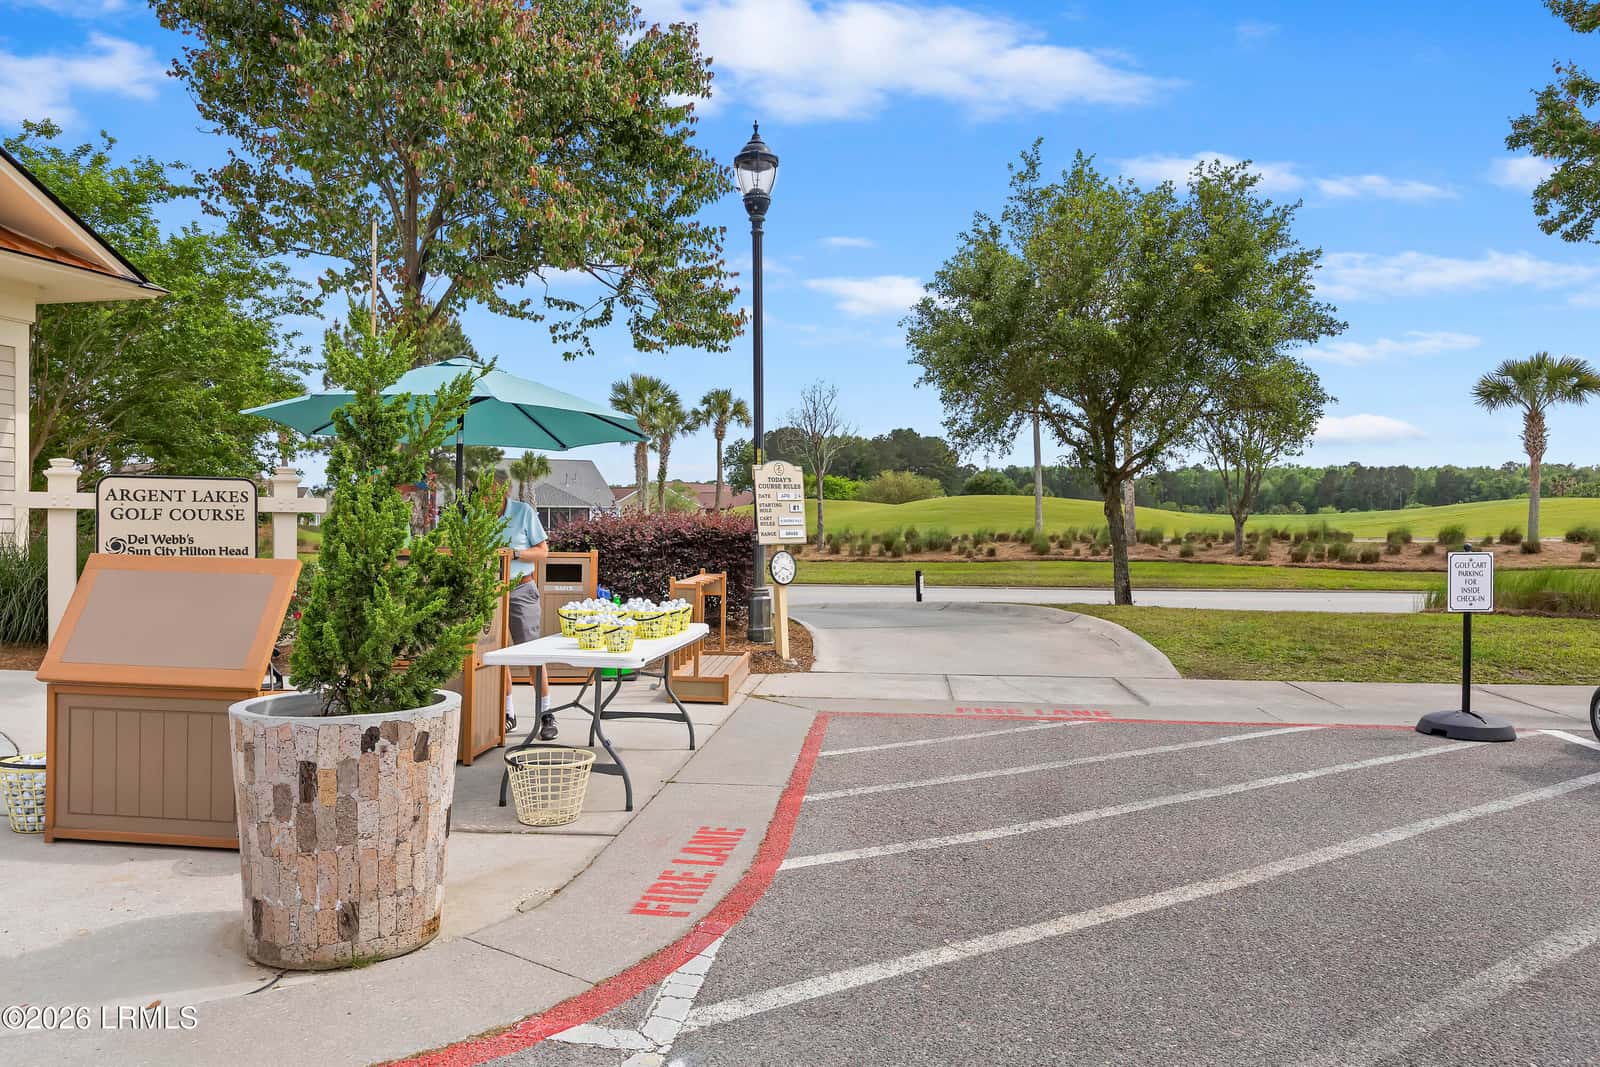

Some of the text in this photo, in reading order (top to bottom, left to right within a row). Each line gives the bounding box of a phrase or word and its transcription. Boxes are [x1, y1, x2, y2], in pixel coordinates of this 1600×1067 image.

[105, 488, 249, 503] ARGENT LAKES
[110, 507, 246, 522] GOLF COURSE
[127, 534, 194, 545] Del Webb's
[127, 546, 249, 556] Sun City Hilton Head
[955, 706, 1112, 717] FIRE LANE
[630, 826, 748, 917] FIRE LANE
